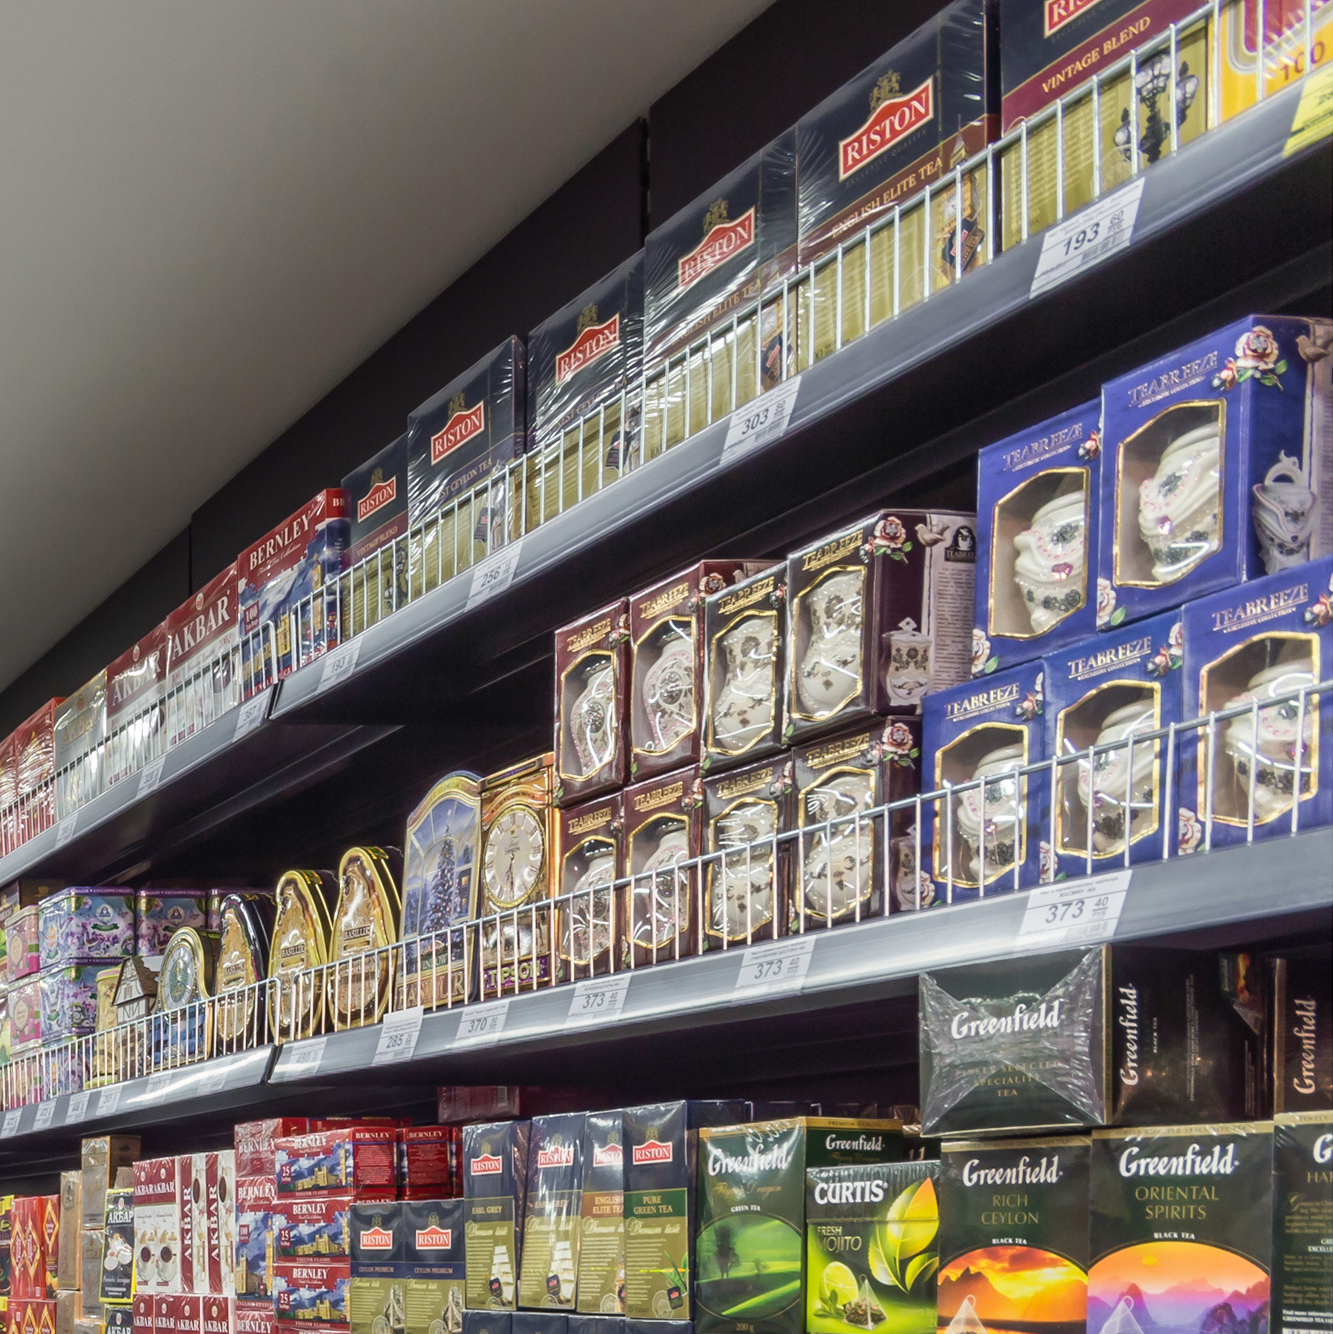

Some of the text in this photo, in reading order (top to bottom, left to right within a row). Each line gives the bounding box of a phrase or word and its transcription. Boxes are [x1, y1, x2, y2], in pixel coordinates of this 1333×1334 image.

[1041, 16, 1151, 93] VINTAGE BLEND
[843, 89, 931, 169] RISTON
[1062, 224, 1101, 257] 193
[434, 410, 484, 461] RISTON
[359, 481, 396, 520] RISTON
[248, 513, 313, 570] BERNLEY
[480, 564, 501, 586] 256
[1211, 584, 1310, 629] TEABREEZE
[172, 596, 230, 658] AKBAR
[1067, 635, 1153, 675] TEABREEZE
[944, 683, 1021, 718] TEABREEZE
[1044, 895, 1109, 924] 373 40
[467, 1017, 488, 1033] 370
[951, 1002, 1063, 1041] Greenfield
[1121, 983, 1139, 1086] Greenfield
[356, 1132, 390, 1140] BERNLEY
[471, 1157, 502, 1174] RISTON
[962, 1155, 1063, 1186] Greenfield
[1119, 1143, 1239, 1178] Greenfield
[813, 1180, 883, 1204] CURTIS
[992, 1193, 1028, 1209] RICH
[1134, 1185, 1219, 1202] ORIENTAL
[108, 1211, 134, 1225] АКБАР
[182, 1187, 192, 1251] AKBAR
[292, 1203, 327, 1216] BERNLEY
[981, 1209, 1039, 1226] CEYLON
[1145, 1203, 1207, 1220] SPIRITS
[360, 1231, 393, 1248] RISTON
[817, 1226, 842, 1236] FRESH
[1154, 1231, 1196, 1241] BLACK TEA
[292, 1268, 329, 1280] BERNLEY
[205, 1320, 228, 1333] AKBAR
